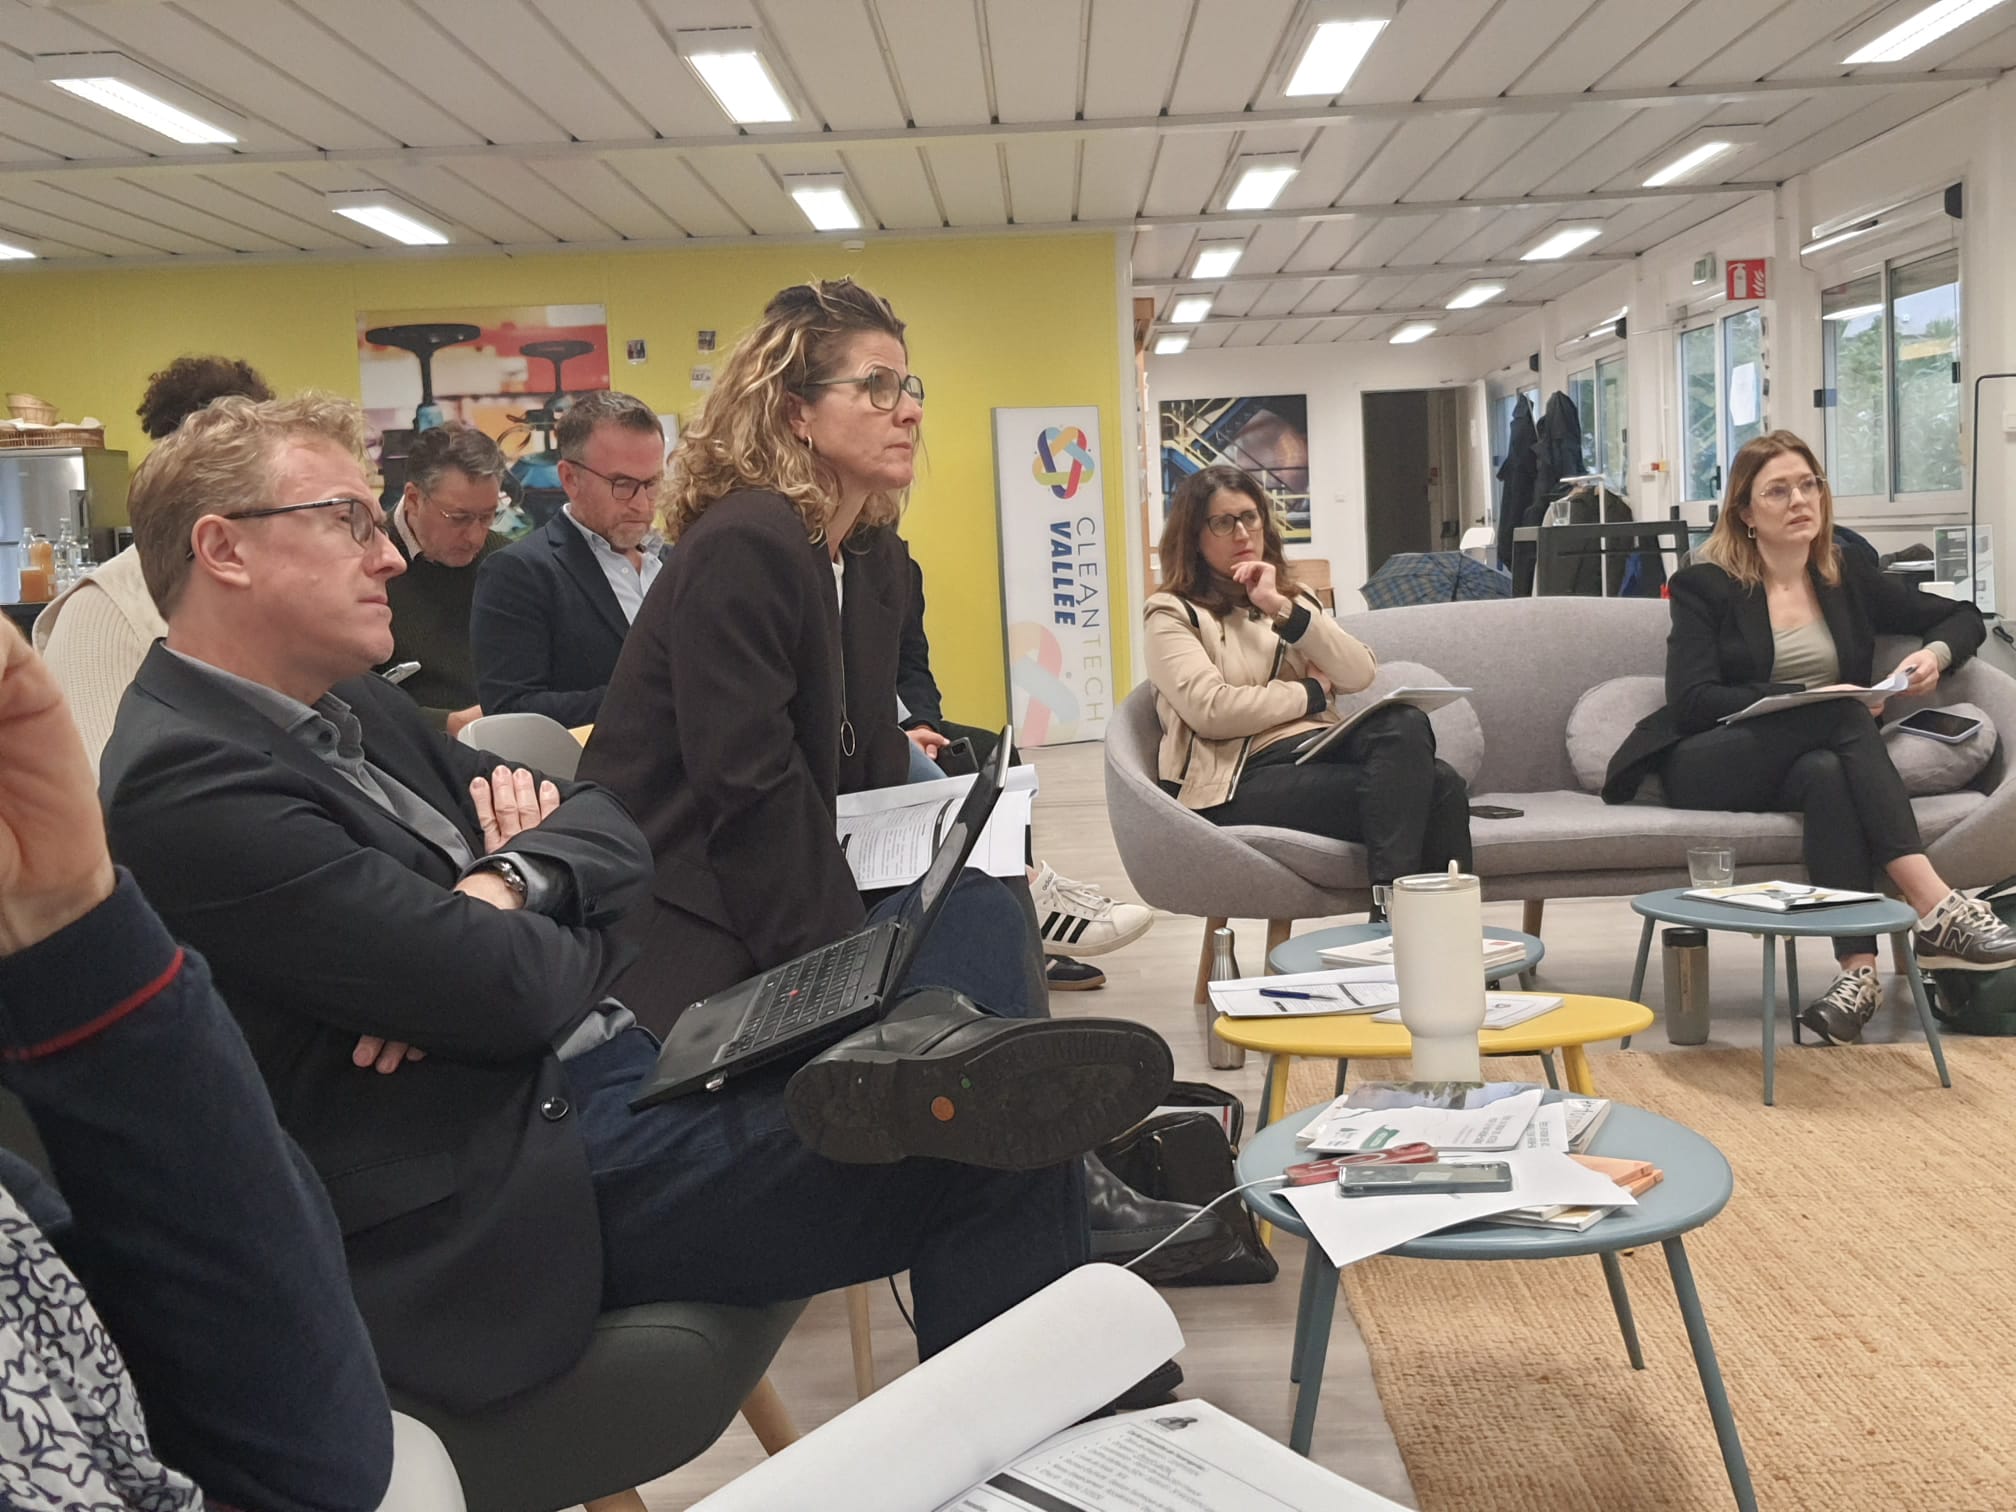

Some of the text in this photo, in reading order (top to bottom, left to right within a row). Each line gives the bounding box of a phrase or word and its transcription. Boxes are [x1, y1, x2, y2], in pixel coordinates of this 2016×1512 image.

[1050, 521, 1079, 625] VALLÉE
[1076, 517, 1104, 721] CLEANTECH
[1944, 927, 1974, 955] N
